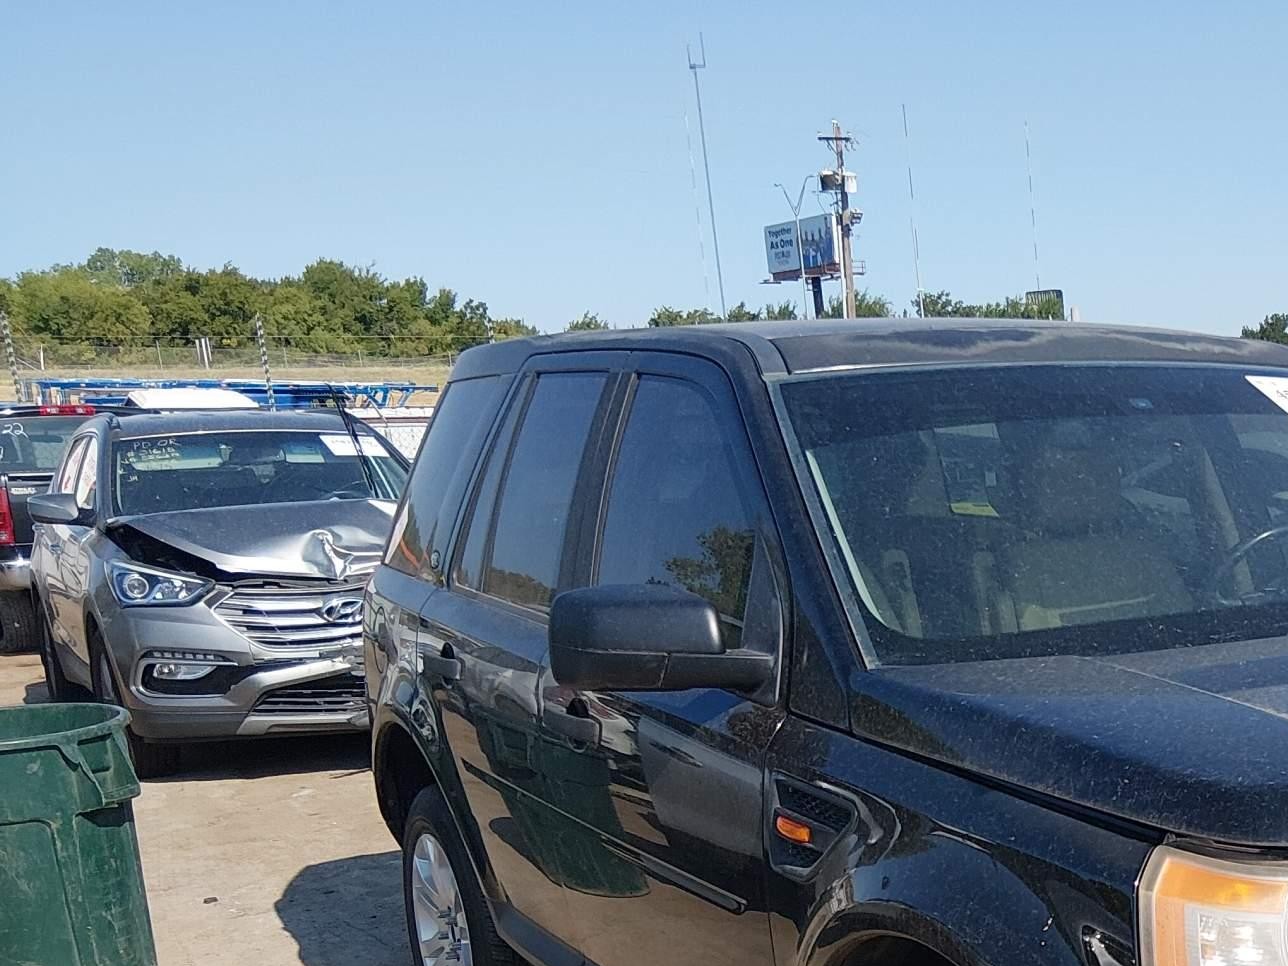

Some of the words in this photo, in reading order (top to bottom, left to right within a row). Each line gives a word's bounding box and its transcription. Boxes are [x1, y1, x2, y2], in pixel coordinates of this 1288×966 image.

[768, 228, 791, 239] Together
[770, 240, 779, 250] As
[780, 239, 793, 248] One
